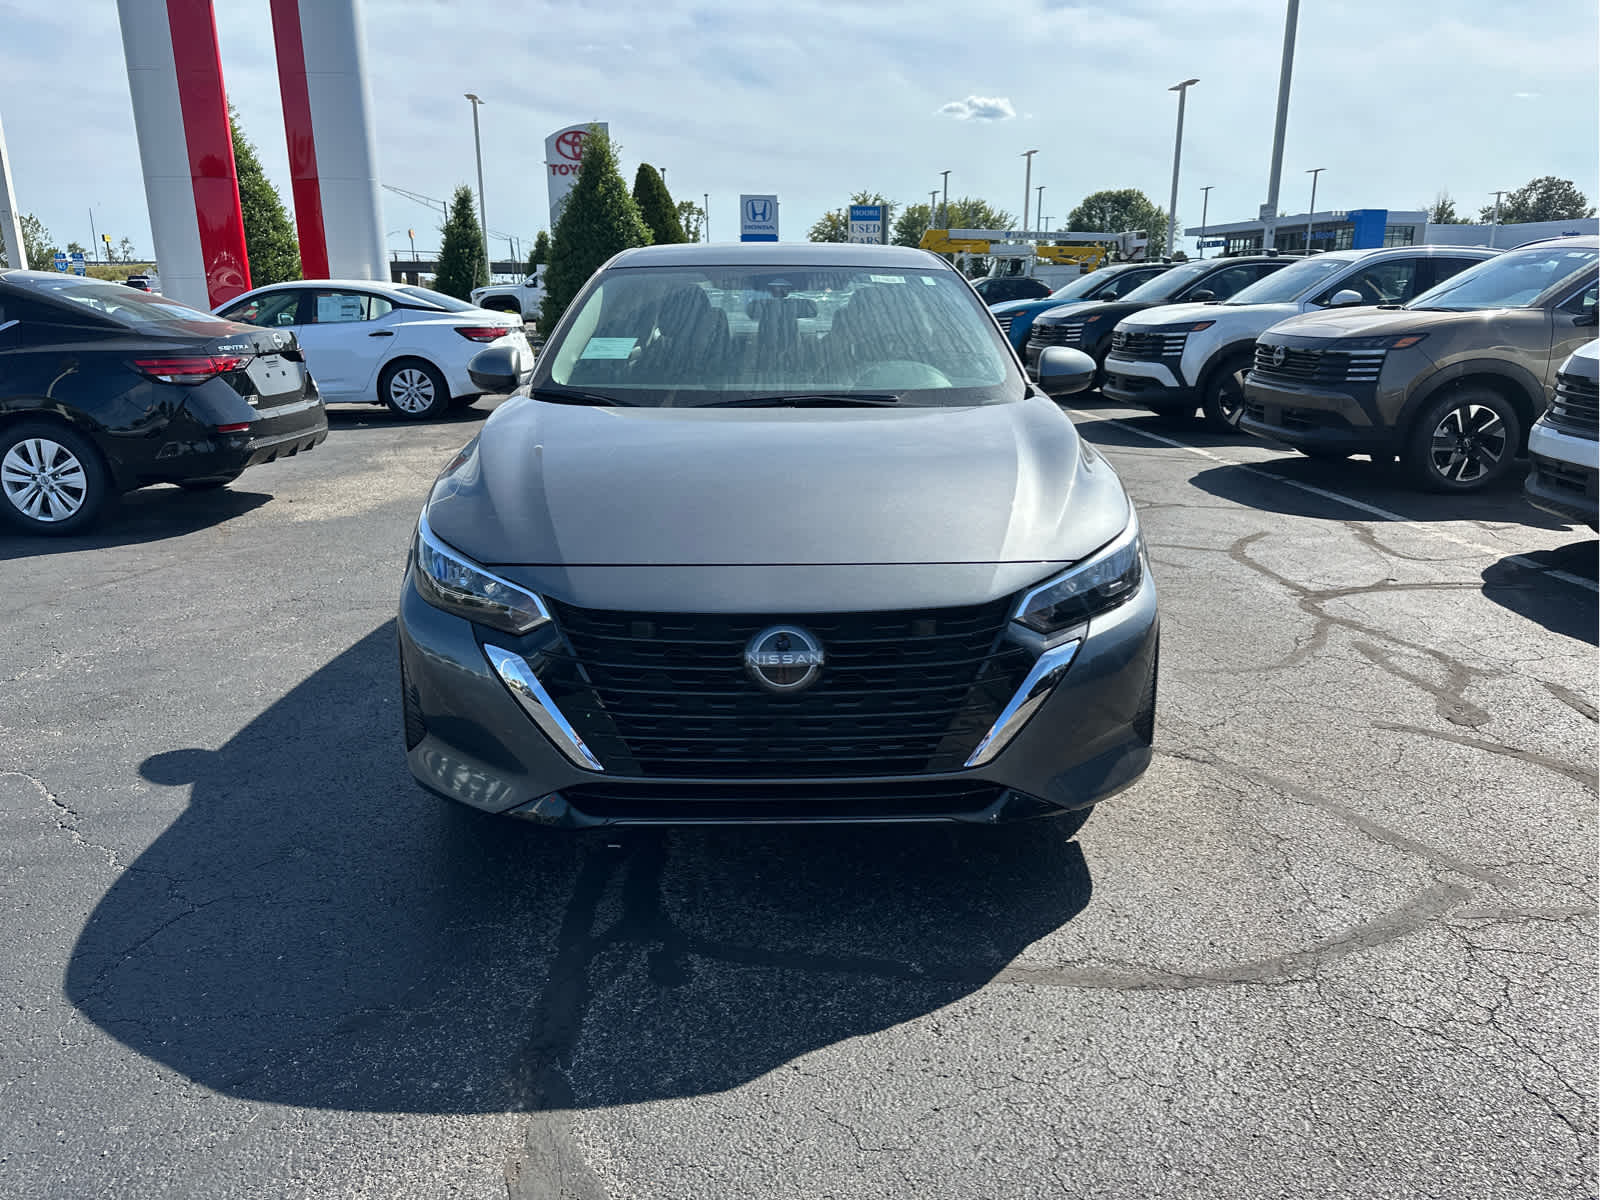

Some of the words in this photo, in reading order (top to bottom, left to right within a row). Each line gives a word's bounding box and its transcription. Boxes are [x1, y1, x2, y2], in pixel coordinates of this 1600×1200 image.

[852, 209, 880, 217] MOORE
[851, 223, 880, 233] USED
[850, 236, 880, 245] CARS
[217, 344, 249, 352] SENTRA
[747, 654, 822, 665] NISSAN
